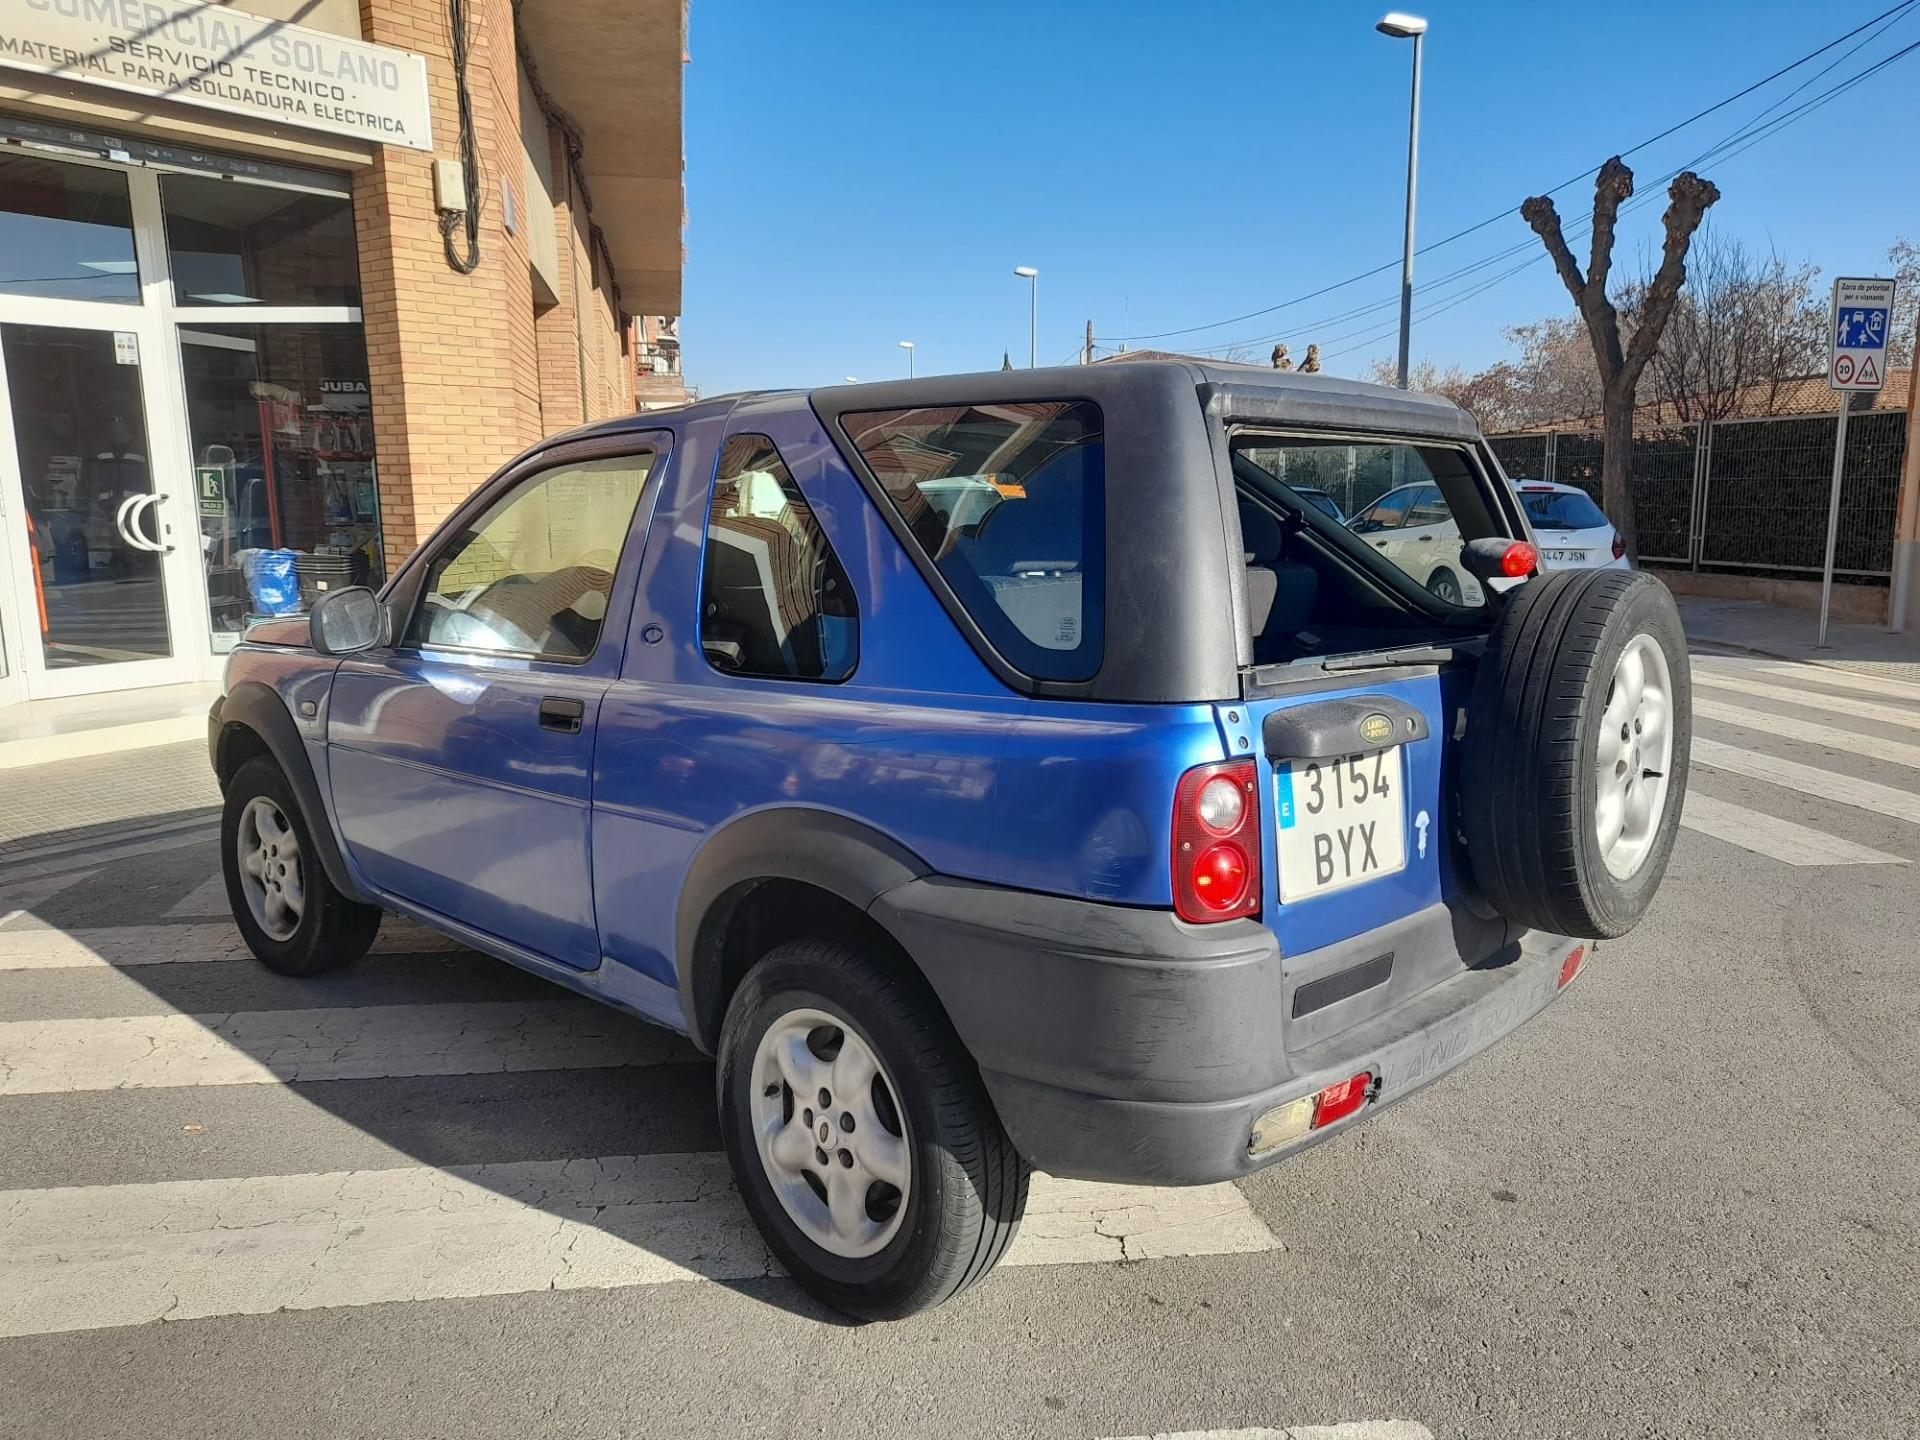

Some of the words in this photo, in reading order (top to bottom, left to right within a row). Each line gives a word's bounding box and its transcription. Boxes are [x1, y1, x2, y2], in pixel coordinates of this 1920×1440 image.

[27, 0, 255, 60] MERCIAL
[270, 33, 399, 91] SOLANO
[0, 35, 116, 75] MATERIAL
[122, 61, 182, 89] PARA
[188, 76, 307, 115] SOLDADURA
[313, 103, 406, 134] ELECTRICA
[108, 35, 234, 77] SERVICIO
[244, 66, 345, 101] TECNICO
[1841, 282, 1857, 291] Zona
[1857, 283, 1865, 291] de
[319, 381, 368, 392] JUBA
[1839, 365, 1850, 374] 20
[1569, 551, 1586, 561] JSN
[1304, 750, 1390, 815] 3154
[1281, 802, 1290, 816] E
[1314, 820, 1378, 886] BYX
